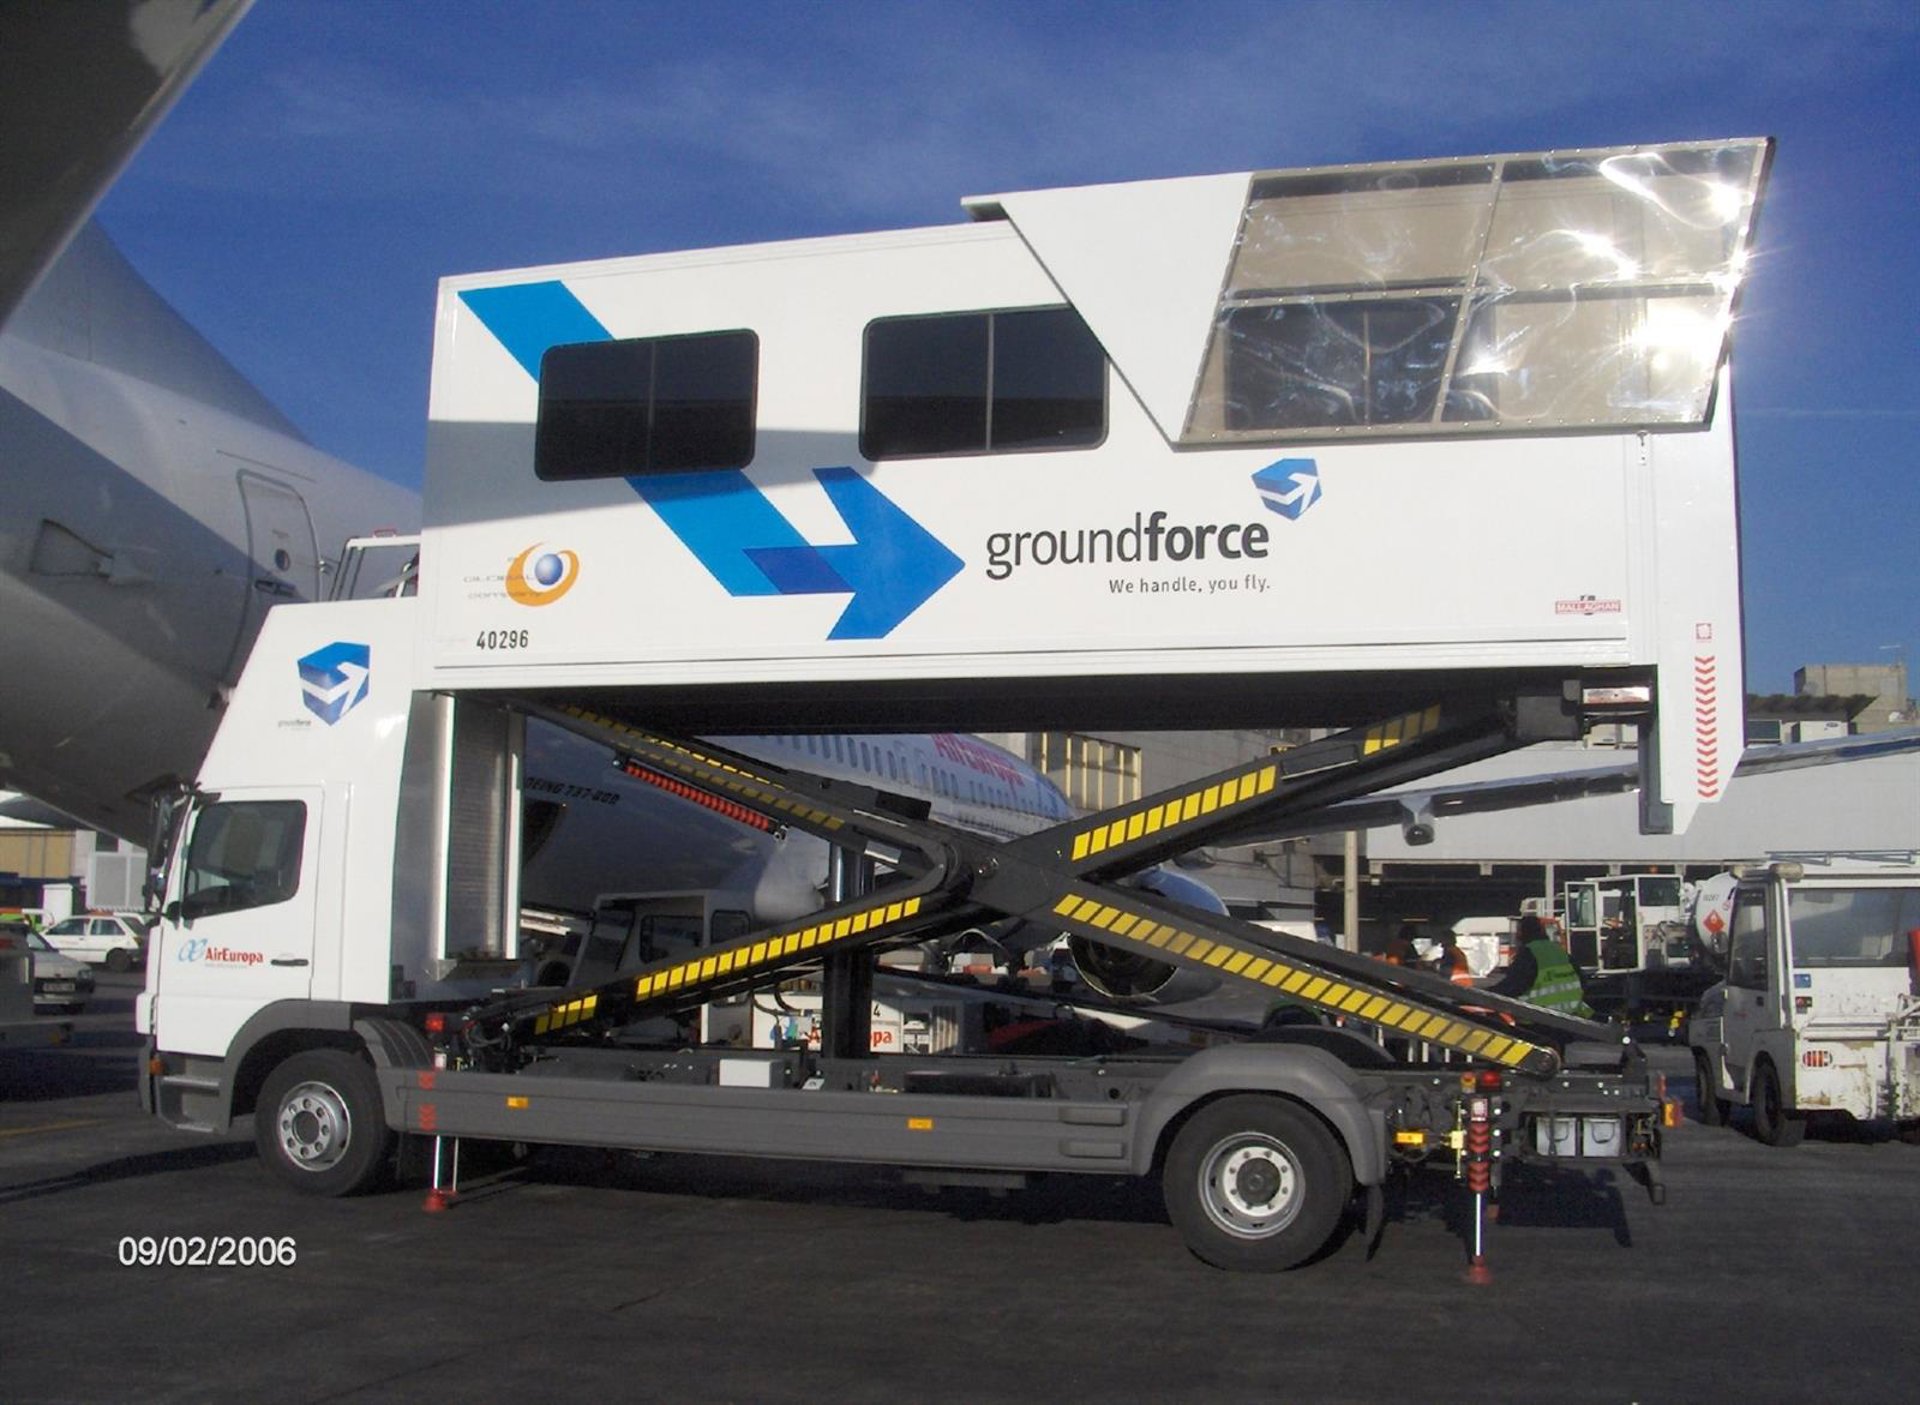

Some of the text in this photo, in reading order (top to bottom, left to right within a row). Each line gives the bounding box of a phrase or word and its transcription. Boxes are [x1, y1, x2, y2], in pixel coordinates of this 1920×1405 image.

[985, 511, 1270, 581] groundforce
[1109, 574, 1271, 594] We handle, you fly.
[476, 630, 528, 650] 40296
[205, 947, 264, 966] AirEuropa
